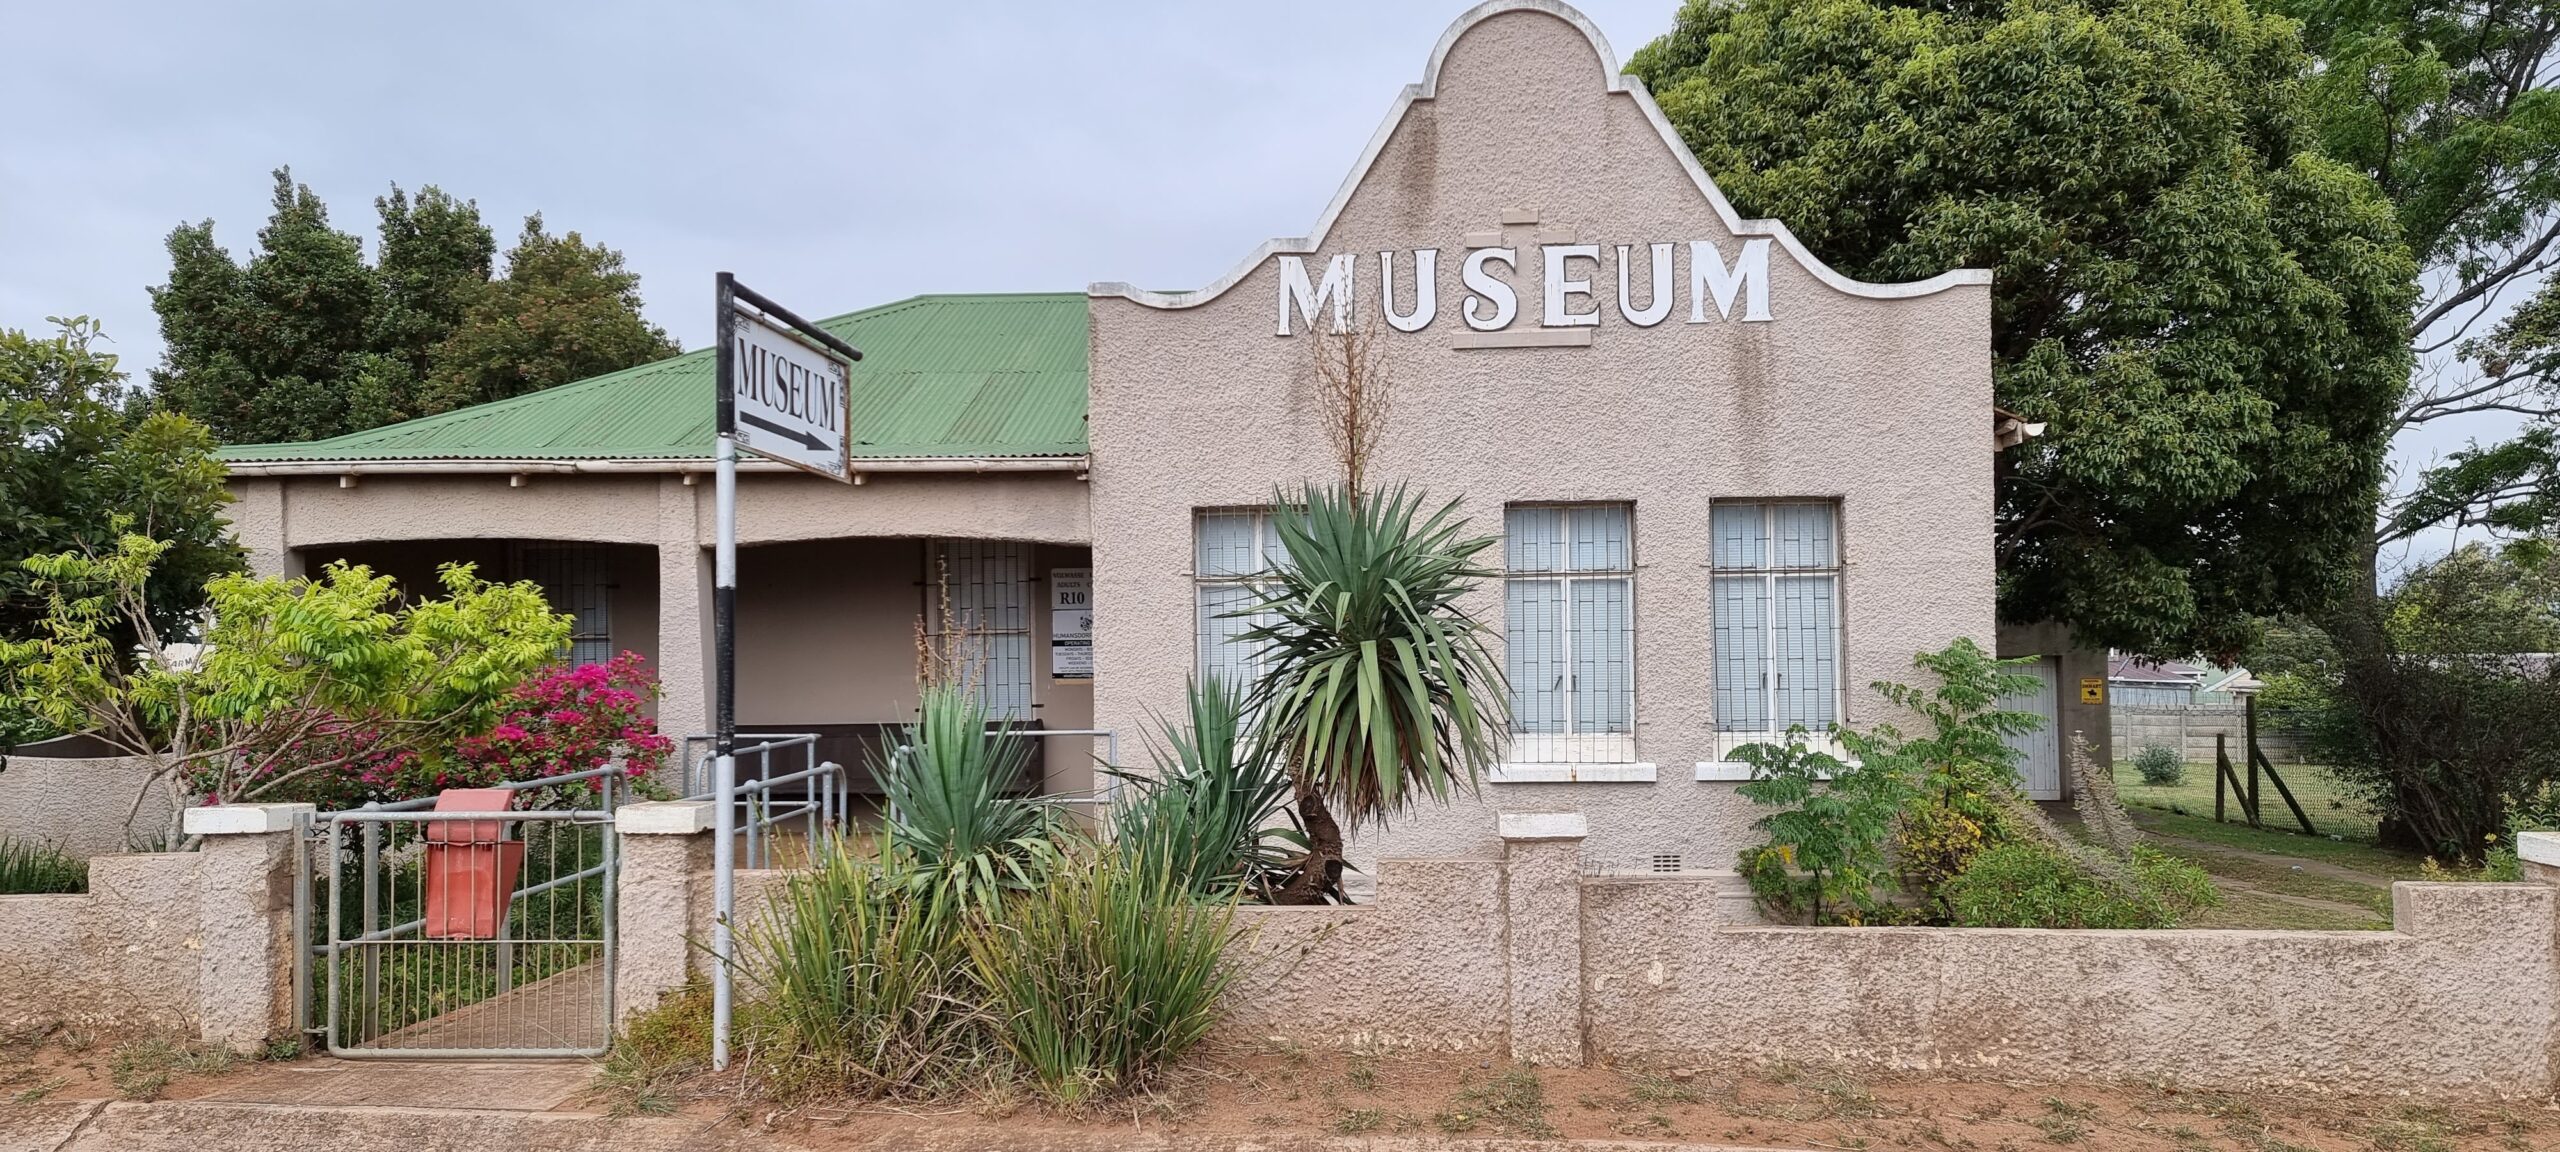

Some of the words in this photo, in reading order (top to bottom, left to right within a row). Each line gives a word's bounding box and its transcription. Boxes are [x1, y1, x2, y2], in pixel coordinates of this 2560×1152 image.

[1275, 239, 1774, 336] MUSEUM
[737, 337, 836, 432] MUSEUM
[1060, 591, 1085, 605] R10
